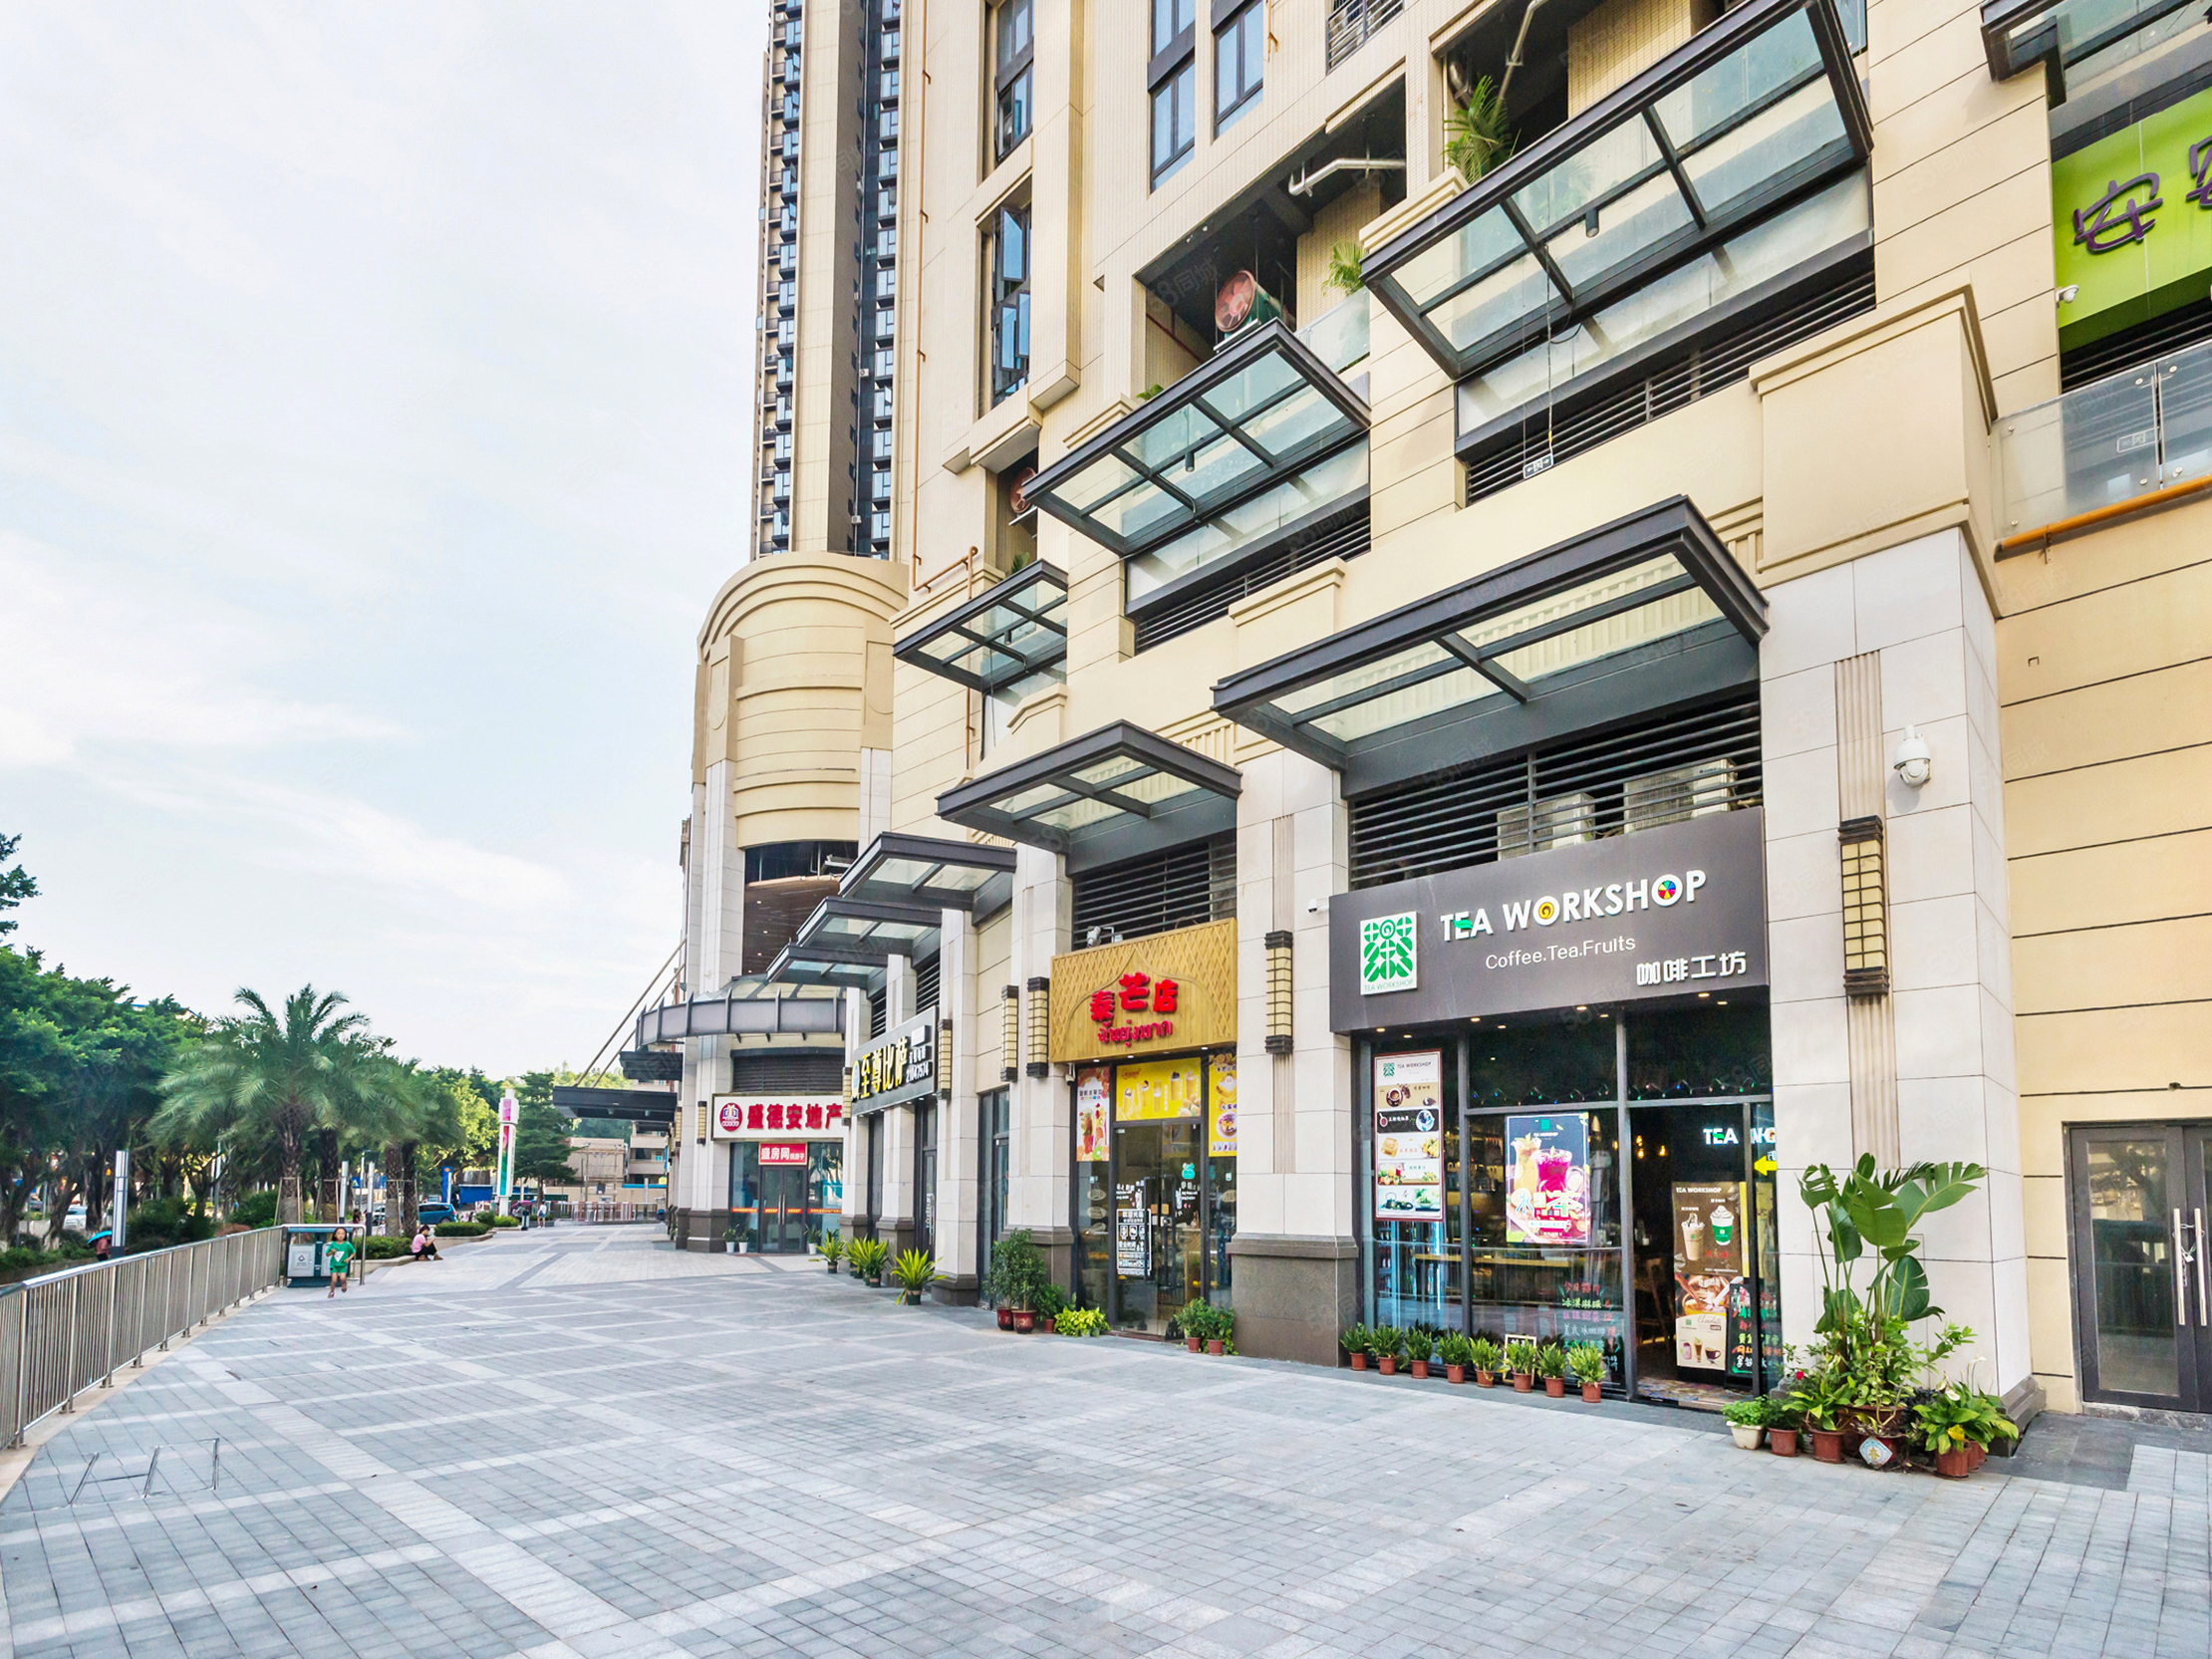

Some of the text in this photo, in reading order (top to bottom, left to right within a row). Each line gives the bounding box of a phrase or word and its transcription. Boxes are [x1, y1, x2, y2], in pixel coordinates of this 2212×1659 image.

[1440, 869, 1708, 943] TEA WORKSHOP
[1636, 951, 1748, 986] 咖啡工坊
[1090, 971, 1179, 1022] 泰芒店
[1364, 978, 1414, 992] TEA WORKSHOP
[747, 1103, 842, 1130] 盛德安地产
[1703, 1127, 1740, 1145] TEA
